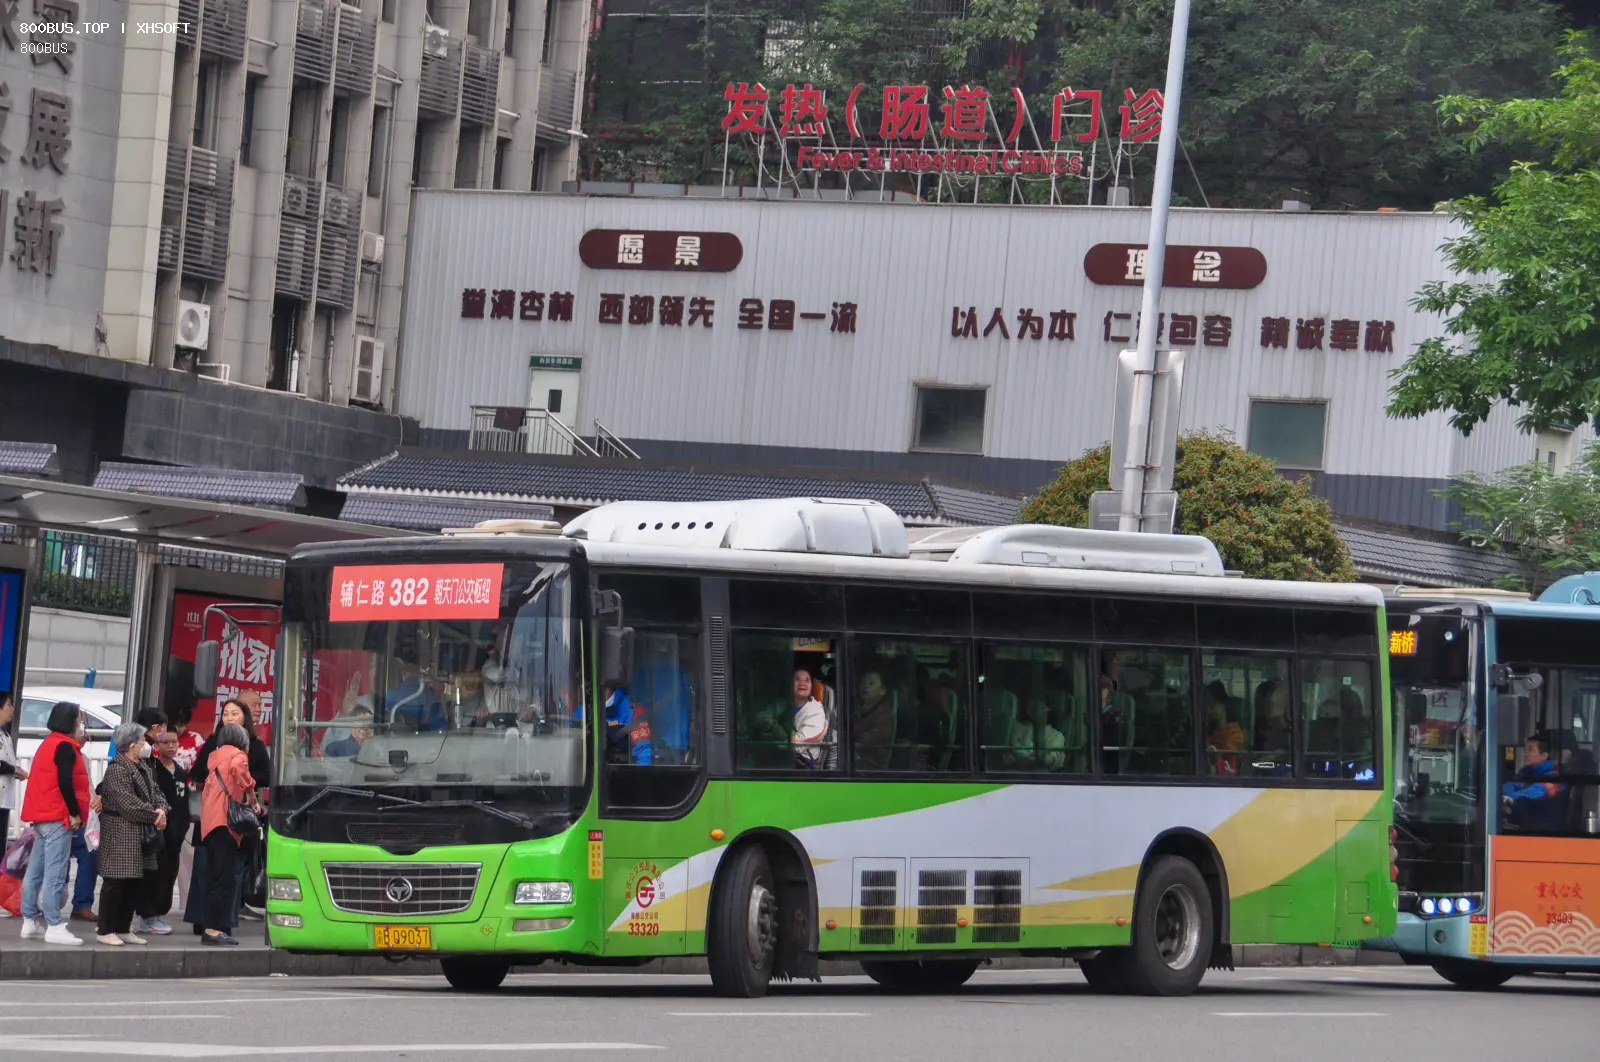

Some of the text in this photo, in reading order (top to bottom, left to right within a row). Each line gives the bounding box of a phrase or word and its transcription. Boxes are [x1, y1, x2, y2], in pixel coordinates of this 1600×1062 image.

[0, 81, 73, 176] 展
[721, 82, 1166, 143] 发热（肠道）门诊
[797, 146, 1082, 175] Fever & Intestinal Clinics
[0, 188, 67, 278] 新
[618, 234, 700, 267] 愿景
[599, 293, 715, 328] 西部领先
[737, 297, 858, 333] 全国一流
[951, 306, 1395, 353] 以人为本 仁包容 精诚奉献
[340, 577, 492, 608] 辅仁路 382 朝天门公交枢纽
[218, 621, 275, 684] 挑家
[1389, 630, 1415, 654] 新桥
[628, 922, 659, 936] 33320
